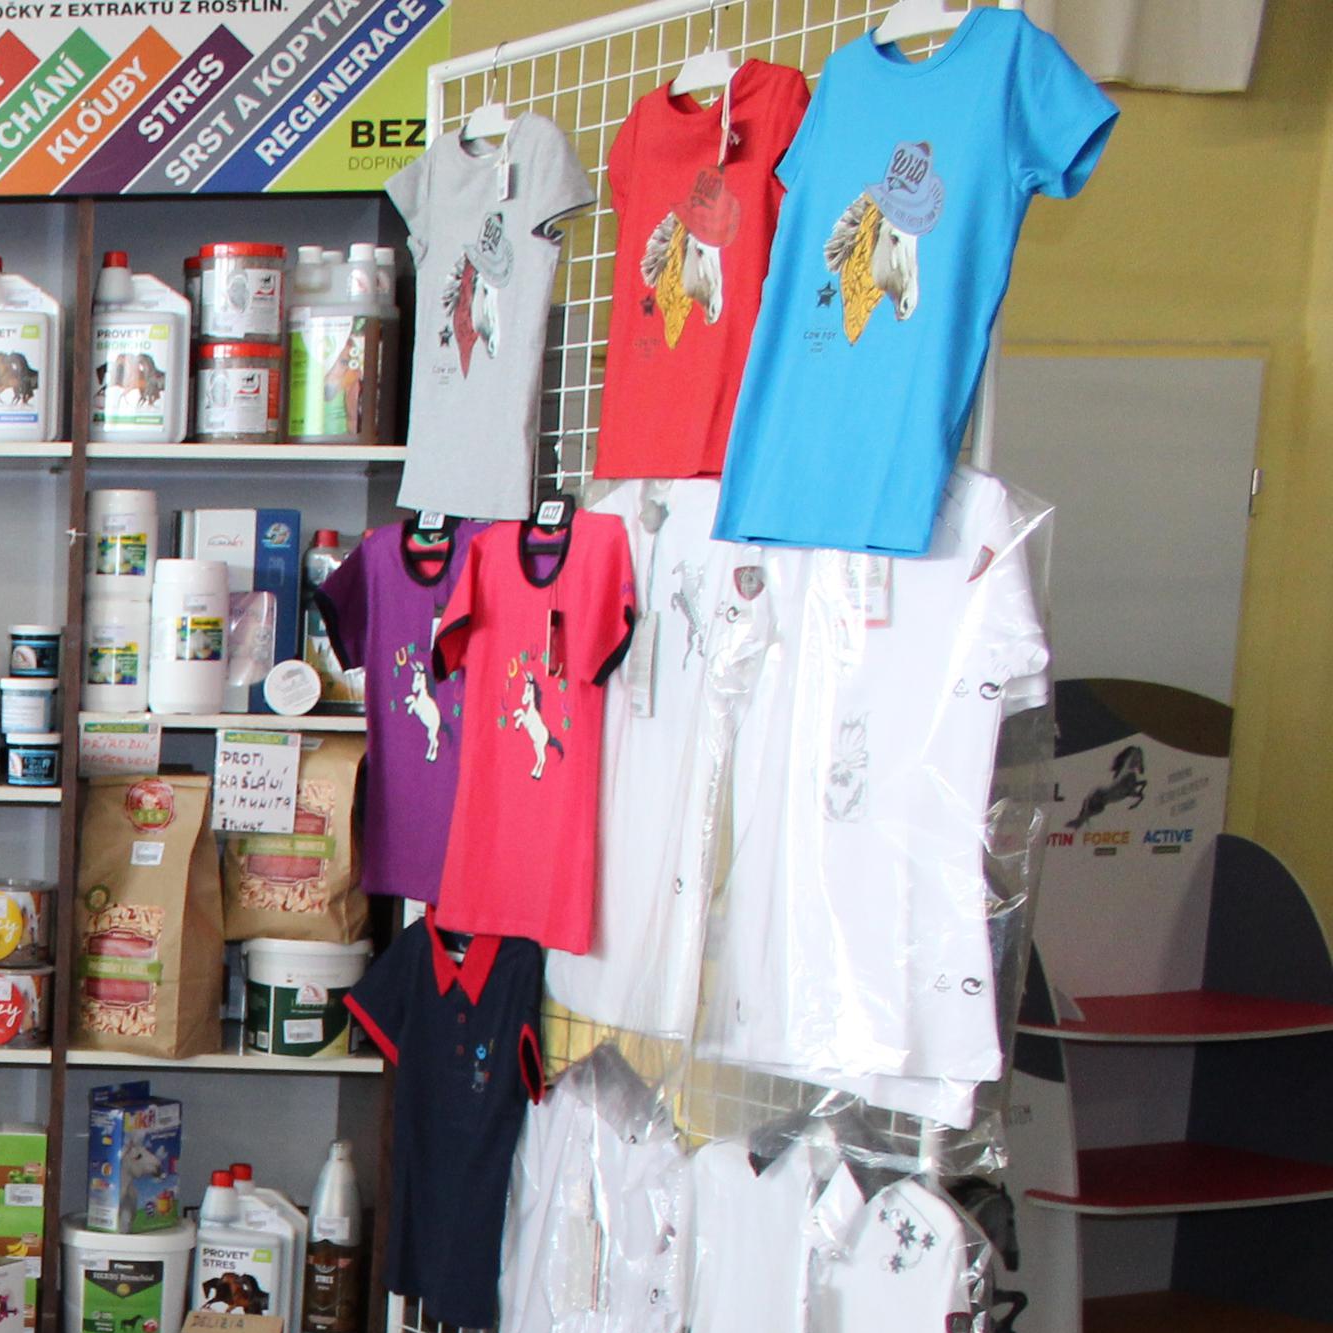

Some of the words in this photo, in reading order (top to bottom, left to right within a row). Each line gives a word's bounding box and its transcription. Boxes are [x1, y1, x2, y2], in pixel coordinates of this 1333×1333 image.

[50, 4, 63, 17] Z
[68, 2, 174, 17] EXTRAKTU
[180, 1, 191, 14] Z
[137, 52, 226, 144] STRES
[164, 110, 235, 188] SRST
[234, 93, 261, 121] A
[253, 0, 361, 97] KOPYTA
[254, 0, 427, 167] REGENERACE
[44, 55, 150, 166] KLOUBY
[350, 119, 427, 149] BEZ
[890, 148, 929, 185] Wild
[220, 750, 264, 767] PROTI
[232, 795, 292, 810] IMUNITA
[1083, 831, 1131, 845] FORCE
[1143, 829, 1194, 844] ACTIVE
[202, 1259, 236, 1270] STRES
